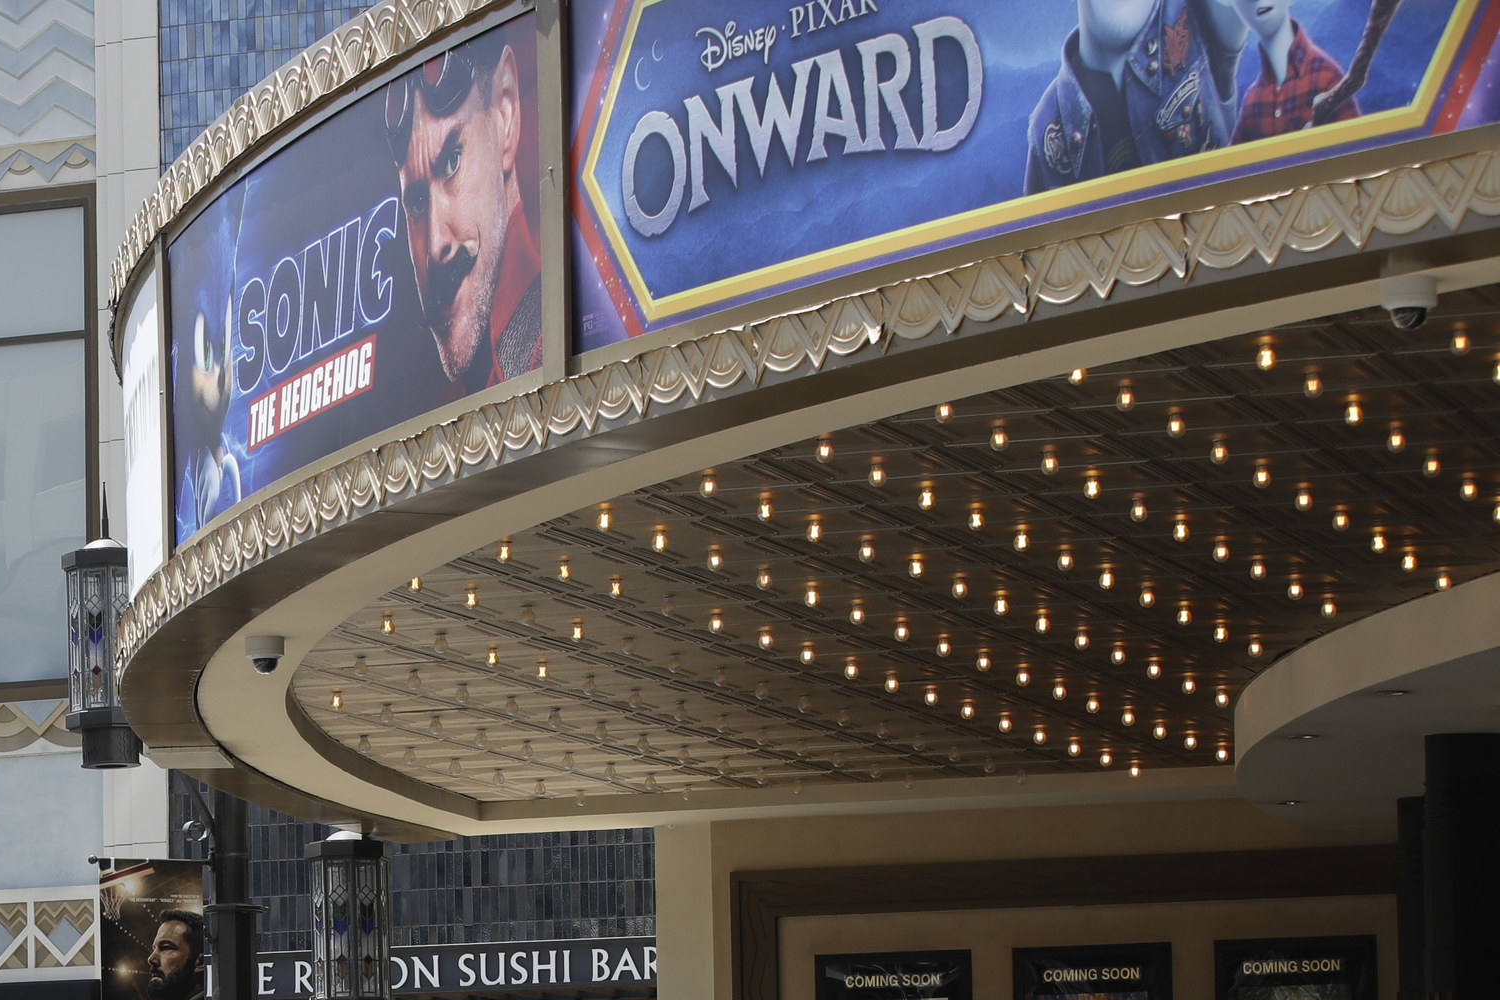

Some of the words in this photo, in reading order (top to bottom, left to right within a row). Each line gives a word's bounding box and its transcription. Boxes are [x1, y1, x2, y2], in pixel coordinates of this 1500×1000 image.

[622, 16, 983, 238] ONWARD
[237, 196, 399, 394] SONIC
[249, 391, 277, 448] THE
[279, 341, 373, 431] HEDGEHOG
[458, 949, 570, 988] SUSHI
[591, 946, 658, 983] BAR
[845, 974, 899, 988] COMING
[902, 973, 940, 986] SOON
[1043, 968, 1098, 982] COMING
[1101, 967, 1140, 980] SOON
[1243, 960, 1298, 975] COMING
[1301, 959, 1341, 972] SOON
